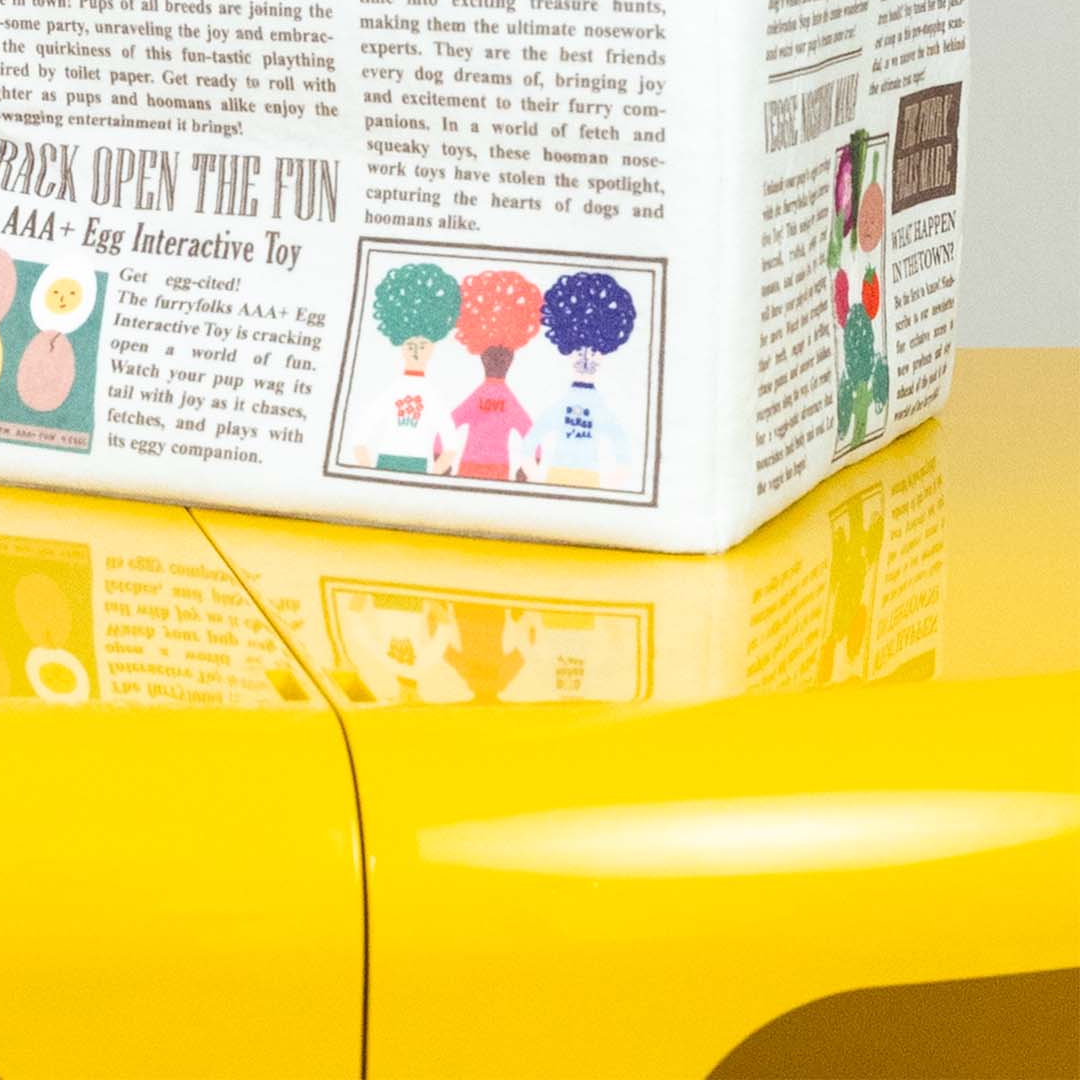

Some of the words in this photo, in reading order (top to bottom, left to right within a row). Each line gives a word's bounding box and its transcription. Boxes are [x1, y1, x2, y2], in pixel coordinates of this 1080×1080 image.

[90, 146, 180, 212] OPEN
[191, 152, 261, 217] THE
[272, 156, 341, 223] FUN
[366, 187, 440, 208] capturing
[453, 190, 478, 206] the
[491, 192, 541, 211] hearts
[555, 197, 572, 213] of
[583, 199, 619, 220] dogs
[632, 203, 664, 219] and
[1, 205, 75, 241] AAA+
[81, 216, 125, 256] Egg
[132, 221, 255, 263] Interactive
[265, 230, 303, 271] Toy
[915, 210, 958, 241] HAPPEN
[919, 243, 955, 270] TOWN?
[119, 267, 148, 283] Get
[165, 275, 241, 292] egg-cited!
[118, 290, 147, 306] The
[155, 294, 232, 315] furryfolks
[238, 303, 288, 319] AAA+
[296, 307, 326, 328] Egg
[113, 313, 200, 335] Interactive
[204, 322, 232, 342] Toy
[236, 325, 248, 340] is
[252, 330, 322, 351] cracking
[110, 339, 149, 354] open
[165, 346, 175, 356] a
[192, 347, 237, 362] world
[253, 352, 272, 366] of
[285, 354, 316, 371] fun.
[479, 397, 506, 414] LOVE
[108, 432, 125, 448] its
[130, 439, 166, 456] eggy
[171, 443, 262, 464] companion.
